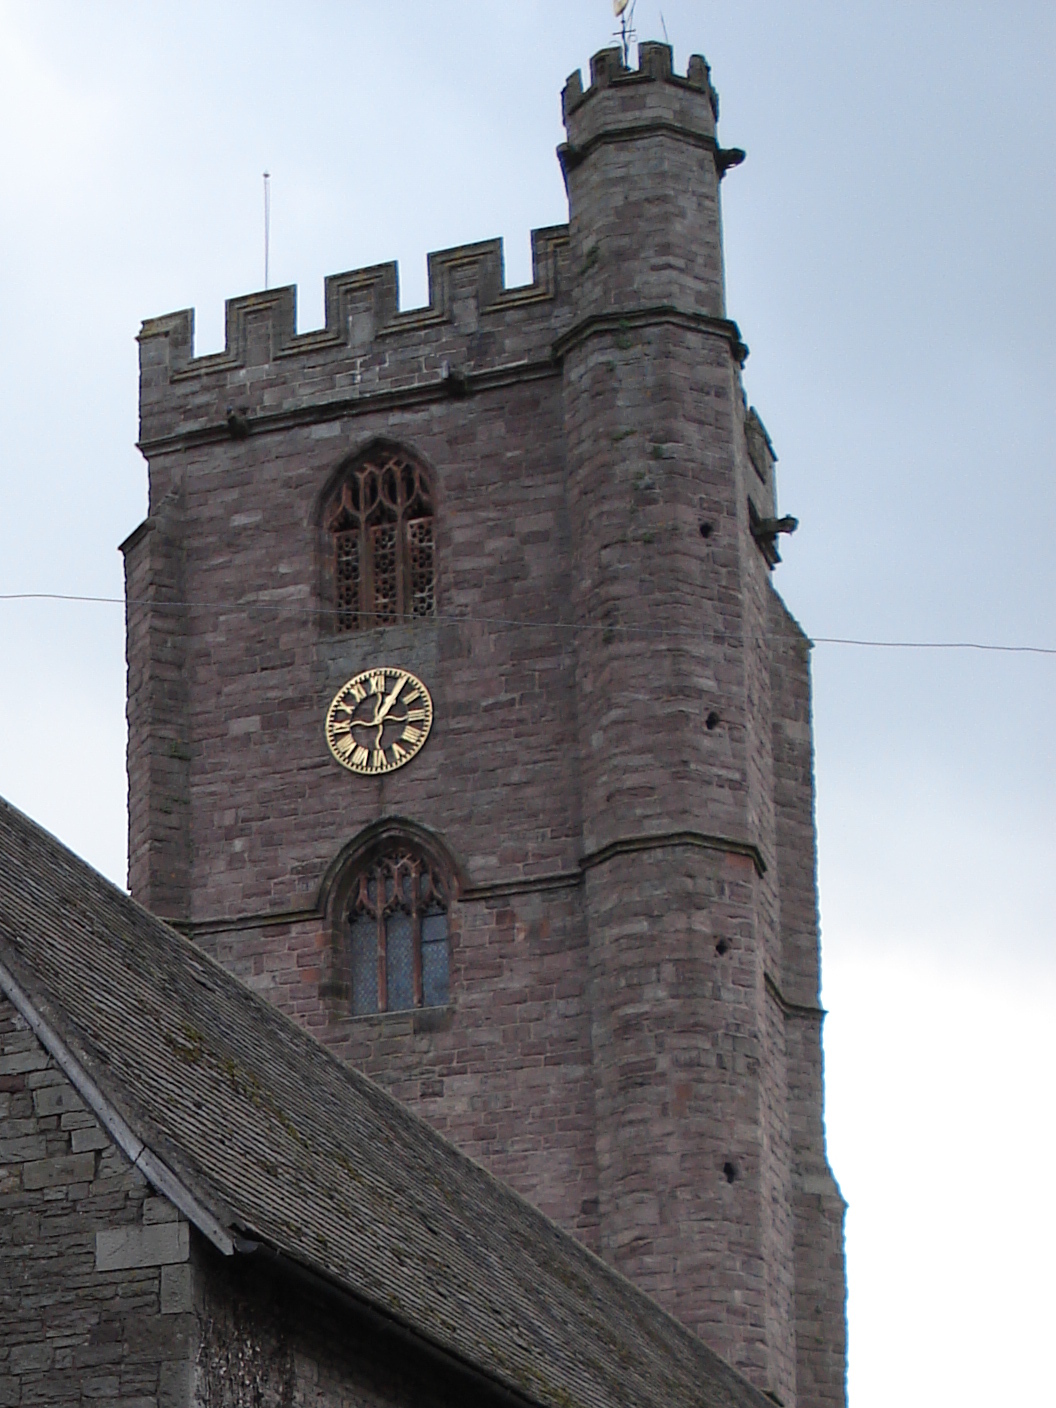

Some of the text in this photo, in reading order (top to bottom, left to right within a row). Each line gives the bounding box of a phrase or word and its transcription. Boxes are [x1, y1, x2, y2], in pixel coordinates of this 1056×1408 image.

[369, 675, 386, 693] XII
[350, 683, 367, 703] XI
[402, 690, 421, 705] II
[336, 701, 355, 715] X
[407, 708, 426, 722] III
[332, 719, 351, 734] IX
[373, 749, 387, 767] VI
[392, 742, 407, 761] V
